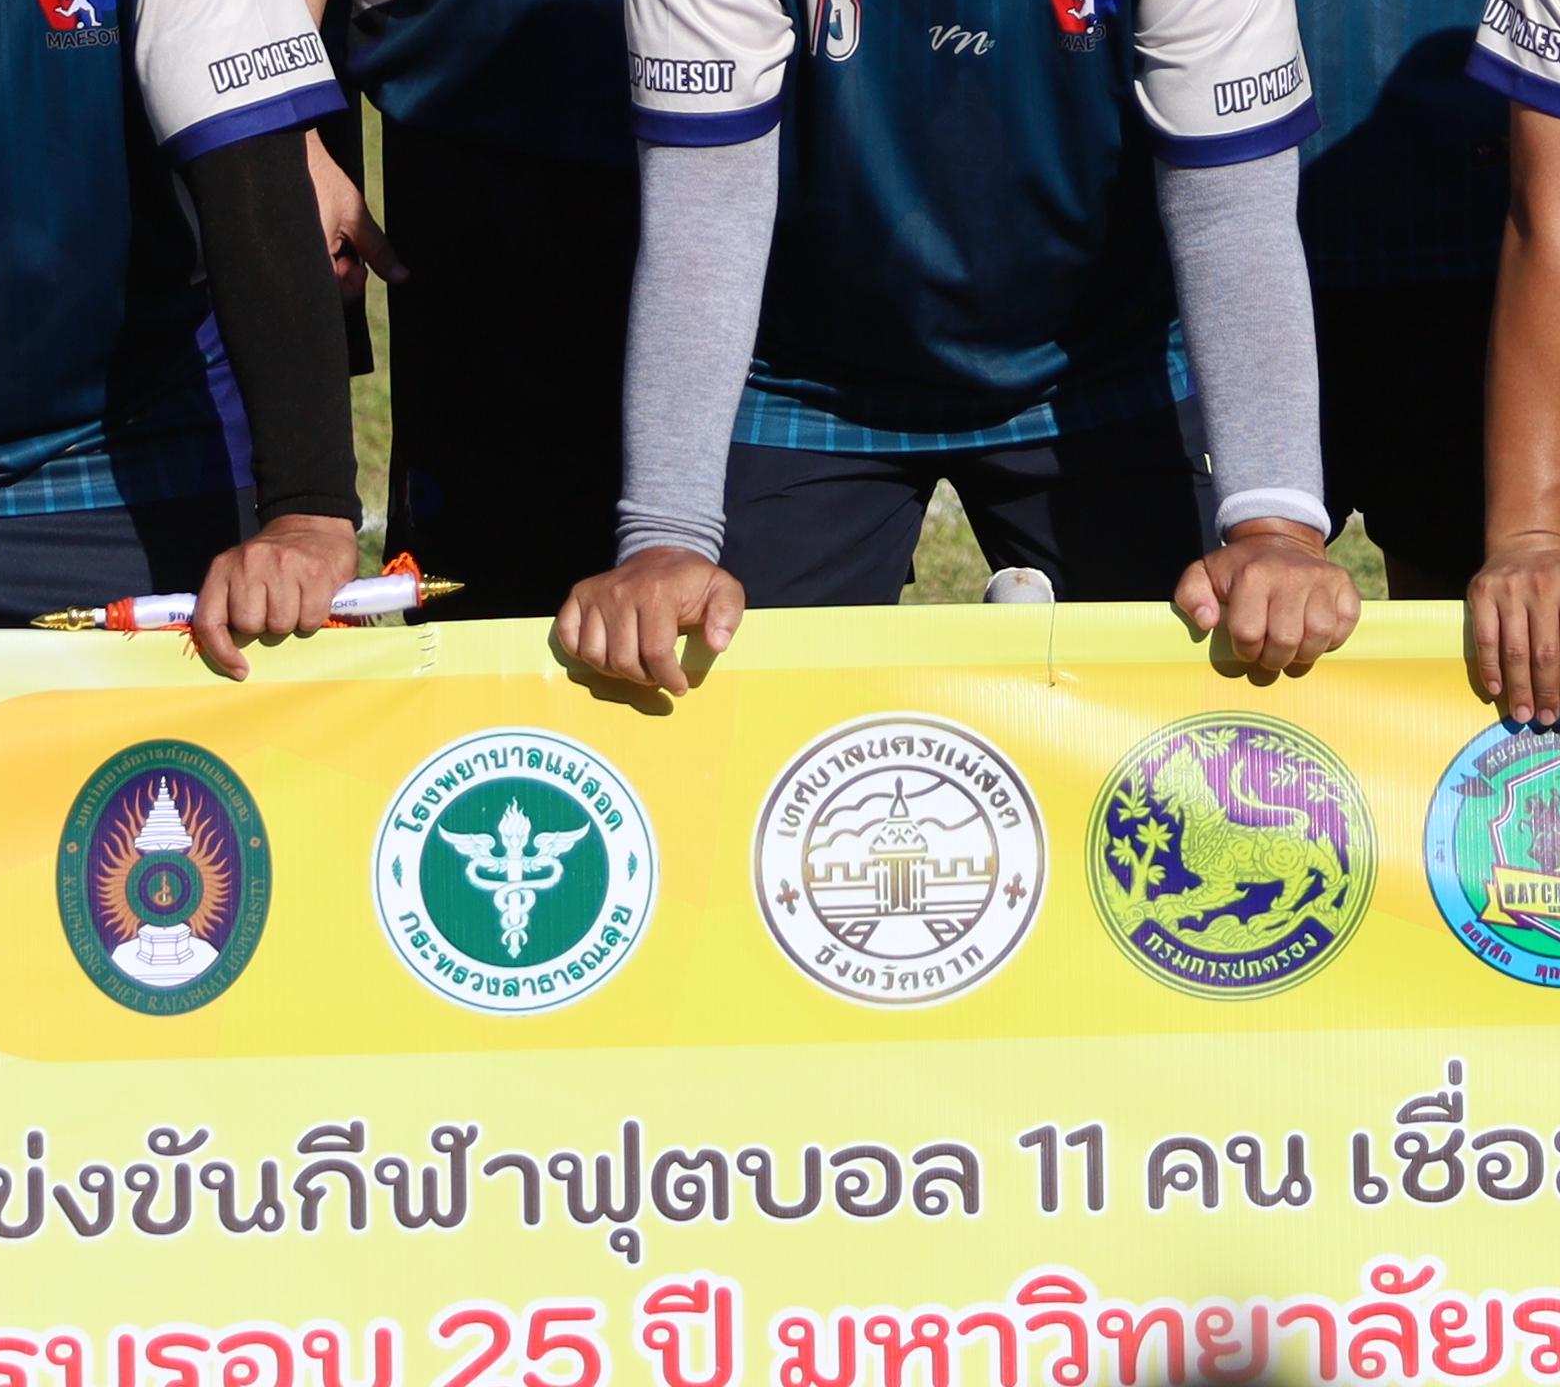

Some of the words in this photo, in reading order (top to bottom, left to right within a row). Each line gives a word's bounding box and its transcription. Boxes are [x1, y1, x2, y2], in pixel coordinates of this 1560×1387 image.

[46, 26, 120, 49] MAESOT
[209, 53, 253, 94] VIP
[252, 32, 323, 80] MAESOT
[644, 58, 736, 94] MAESOT
[1214, 77, 1257, 117] VIP
[393, 744, 623, 835] โรงพยาบาลแม่สอด
[776, 735, 1021, 839] เทศบาลนครแม่สอด
[396, 902, 634, 999] กระทรวงสาธารณสุข
[1143, 931, 1320, 982] กรมการปกครอง
[1017, 1124, 1104, 1213] 11
[1146, 1131, 1312, 1210] คน
[438, 1307, 601, 1387] 25
[641, 1279, 732, 1387] ปี
